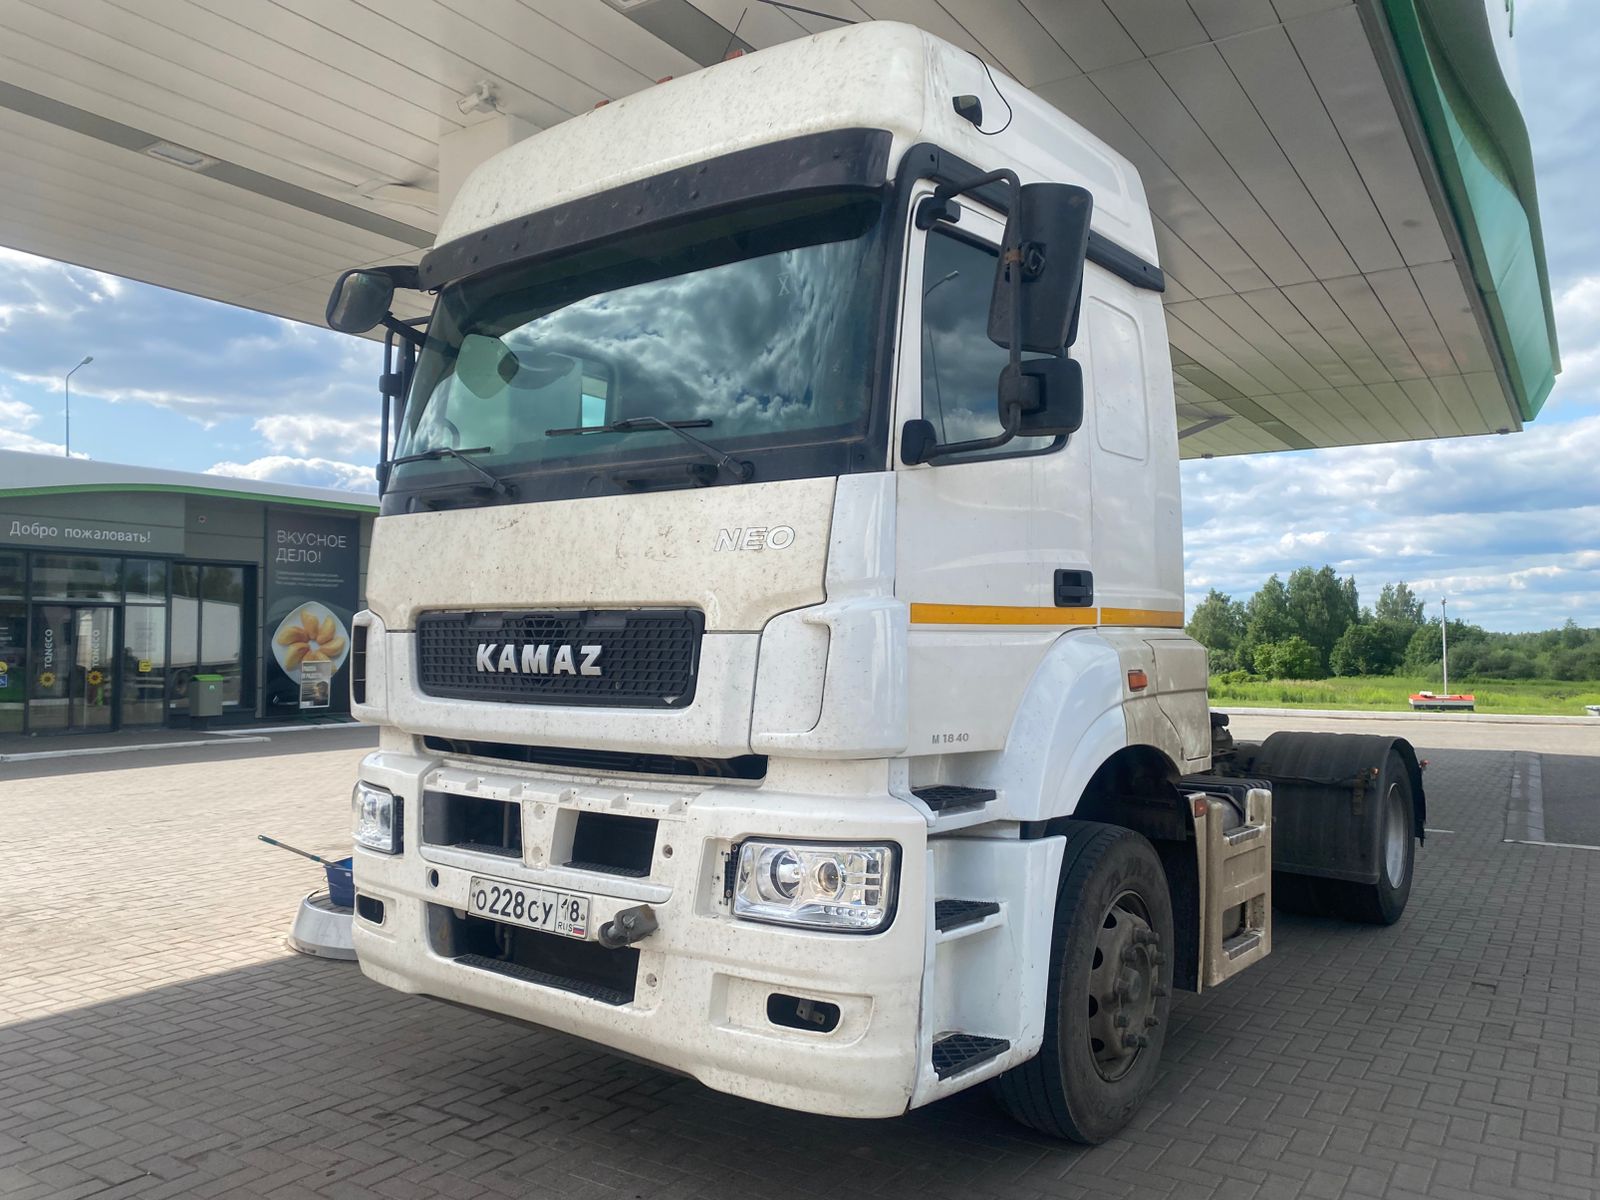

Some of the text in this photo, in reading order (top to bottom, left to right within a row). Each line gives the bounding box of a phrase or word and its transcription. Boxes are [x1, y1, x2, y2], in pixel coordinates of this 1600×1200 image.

[9, 521, 151, 543] Добро пожаловать!
[276, 530, 347, 548] ВКУСНОЕ
[714, 525, 796, 553] NEO
[275, 547, 321, 564] ДЕЛО!
[475, 643, 603, 676] KAMAZ
[557, 921, 573, 933] RUS
